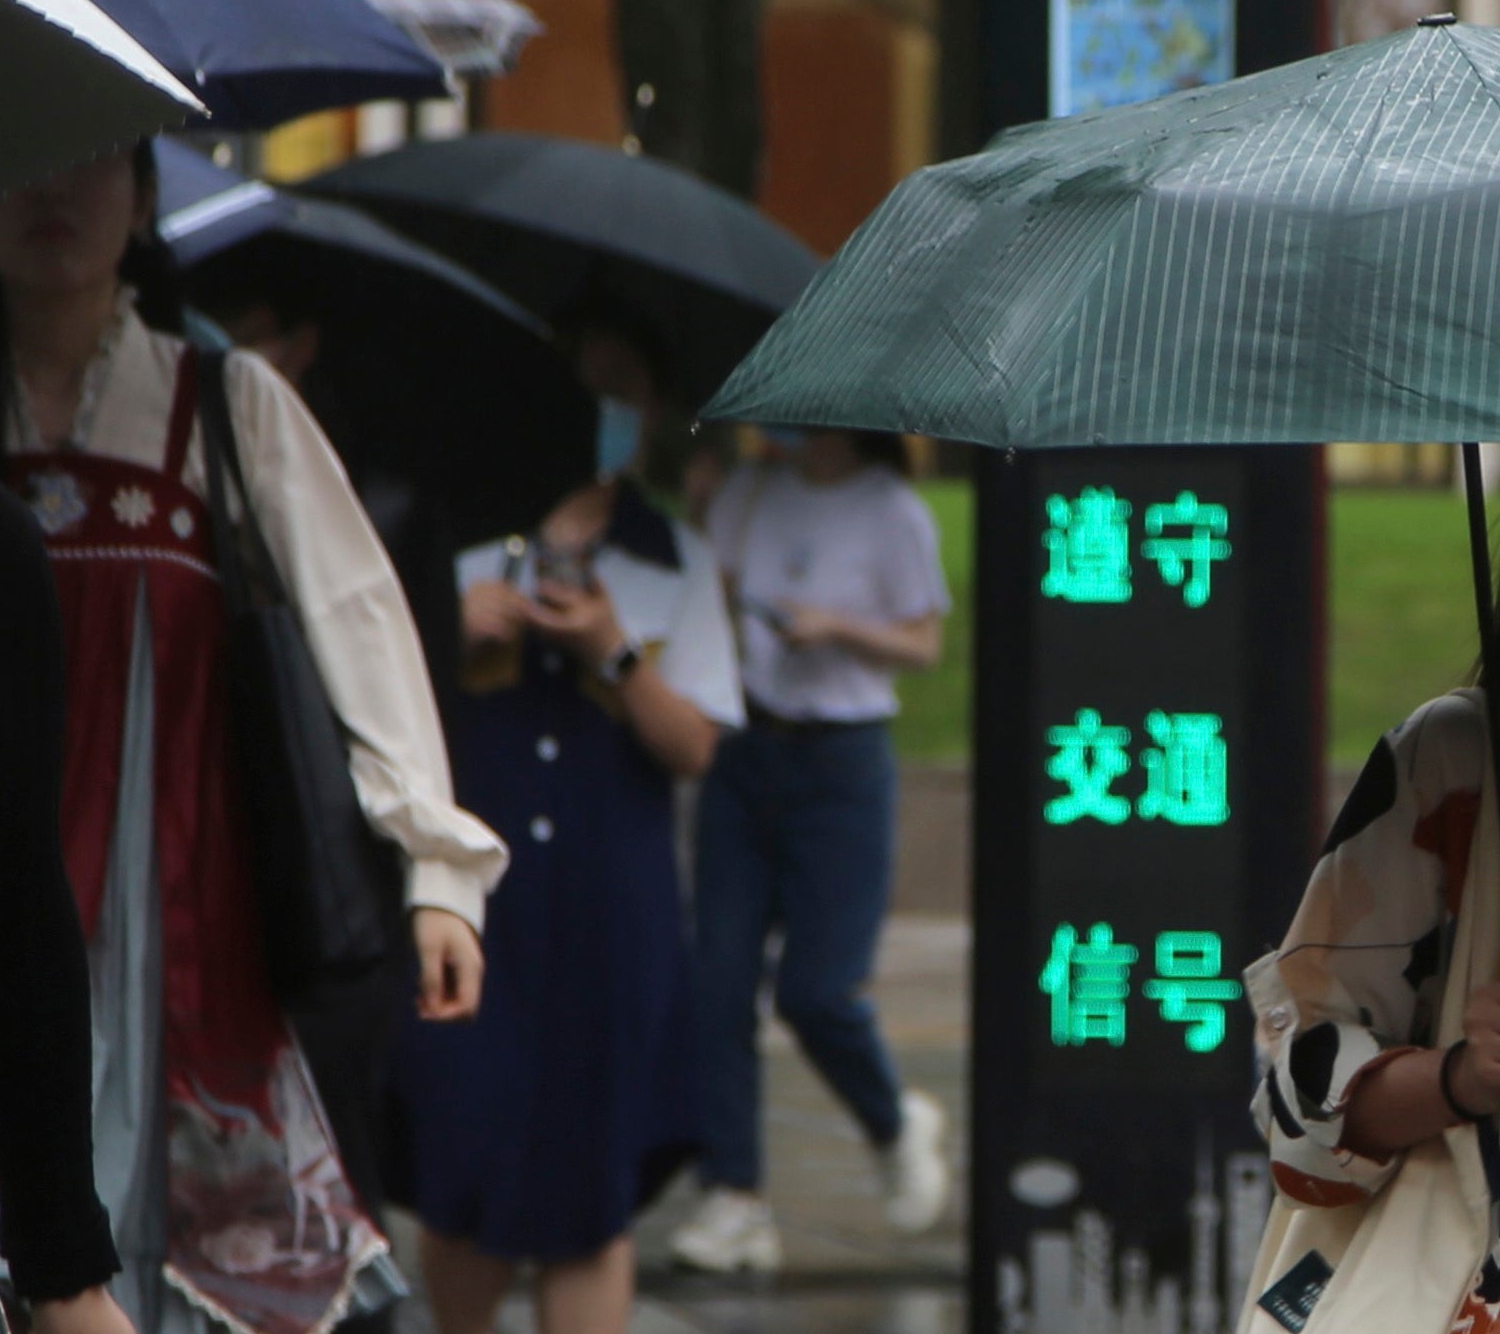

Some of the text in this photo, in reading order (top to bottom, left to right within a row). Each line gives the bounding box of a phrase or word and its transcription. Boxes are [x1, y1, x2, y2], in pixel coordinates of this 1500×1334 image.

[1041, 485, 1232, 608] 遵守
[1044, 707, 1231, 825] 交通
[1038, 921, 1243, 1052] 信号
